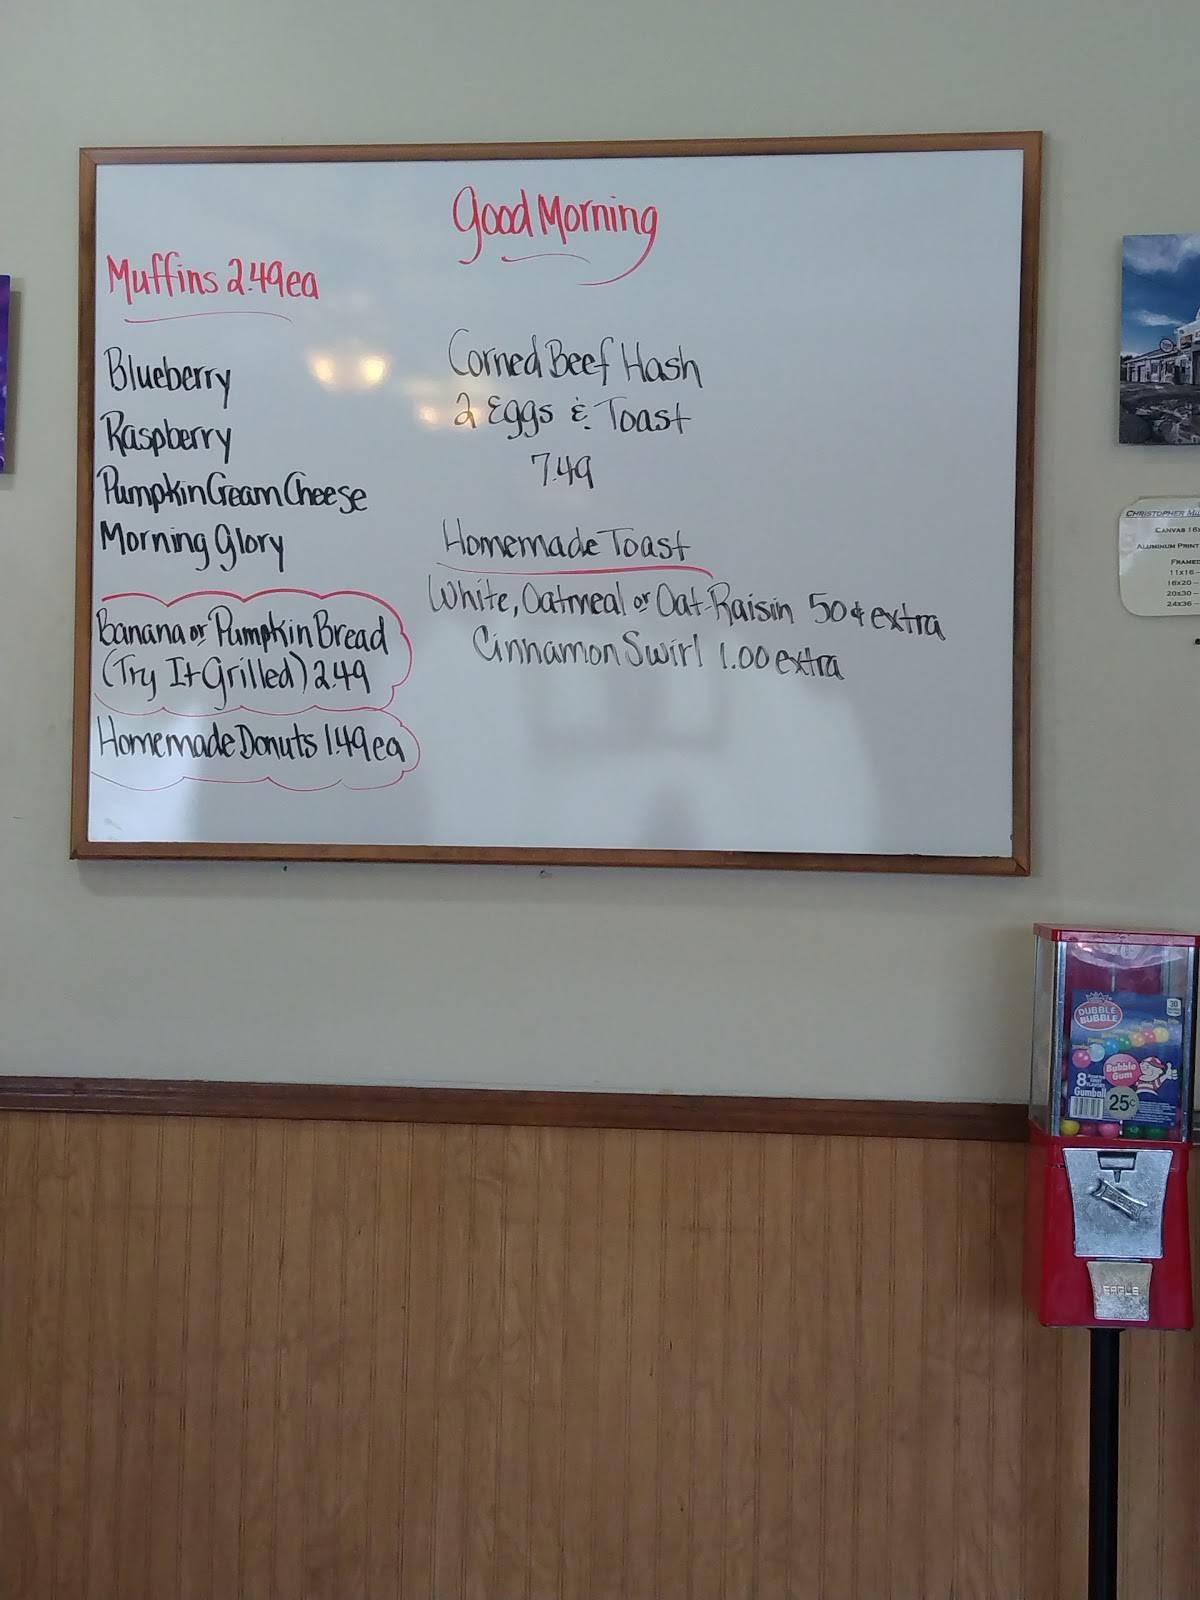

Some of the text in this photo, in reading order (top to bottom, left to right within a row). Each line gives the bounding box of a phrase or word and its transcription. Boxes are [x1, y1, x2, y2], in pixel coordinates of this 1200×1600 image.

[453, 186, 658, 285] Good Morning
[106, 251, 218, 305] Muffins
[103, 346, 231, 410] Blueberry
[448, 328, 703, 389] Corned Beef Hash
[100, 410, 232, 464] Raspberry
[454, 392, 477, 429] 2
[487, 395, 554, 440] Eggs
[593, 396, 692, 434] Toast
[97, 465, 368, 514] Pumpkin Cream Cheese
[530, 451, 595, 490] 7.49
[100, 520, 284, 573] Morning Glory
[442, 517, 692, 561] Homemade Toast
[96, 605, 389, 656] Banana or Pumpkin Bread
[427, 574, 519, 618] White,
[522, 581, 627, 616] Oatmeal
[633, 591, 652, 613] or
[871, 602, 947, 641] extra
[472, 624, 846, 681] Cinnamon Swirl 1.00 extra
[102, 648, 371, 711] (Try It Grilled) 2.49
[96, 714, 236, 759] Homemade
[234, 722, 318, 760] Donuts
[1077, 1006, 1117, 1016] DUBBLE
[1079, 1014, 1119, 1025] BUBBLE
[1076, 1072, 1087, 1087] 8
[1105, 1062, 1137, 1073] Bubble
[1112, 1072, 1133, 1081] Gum
